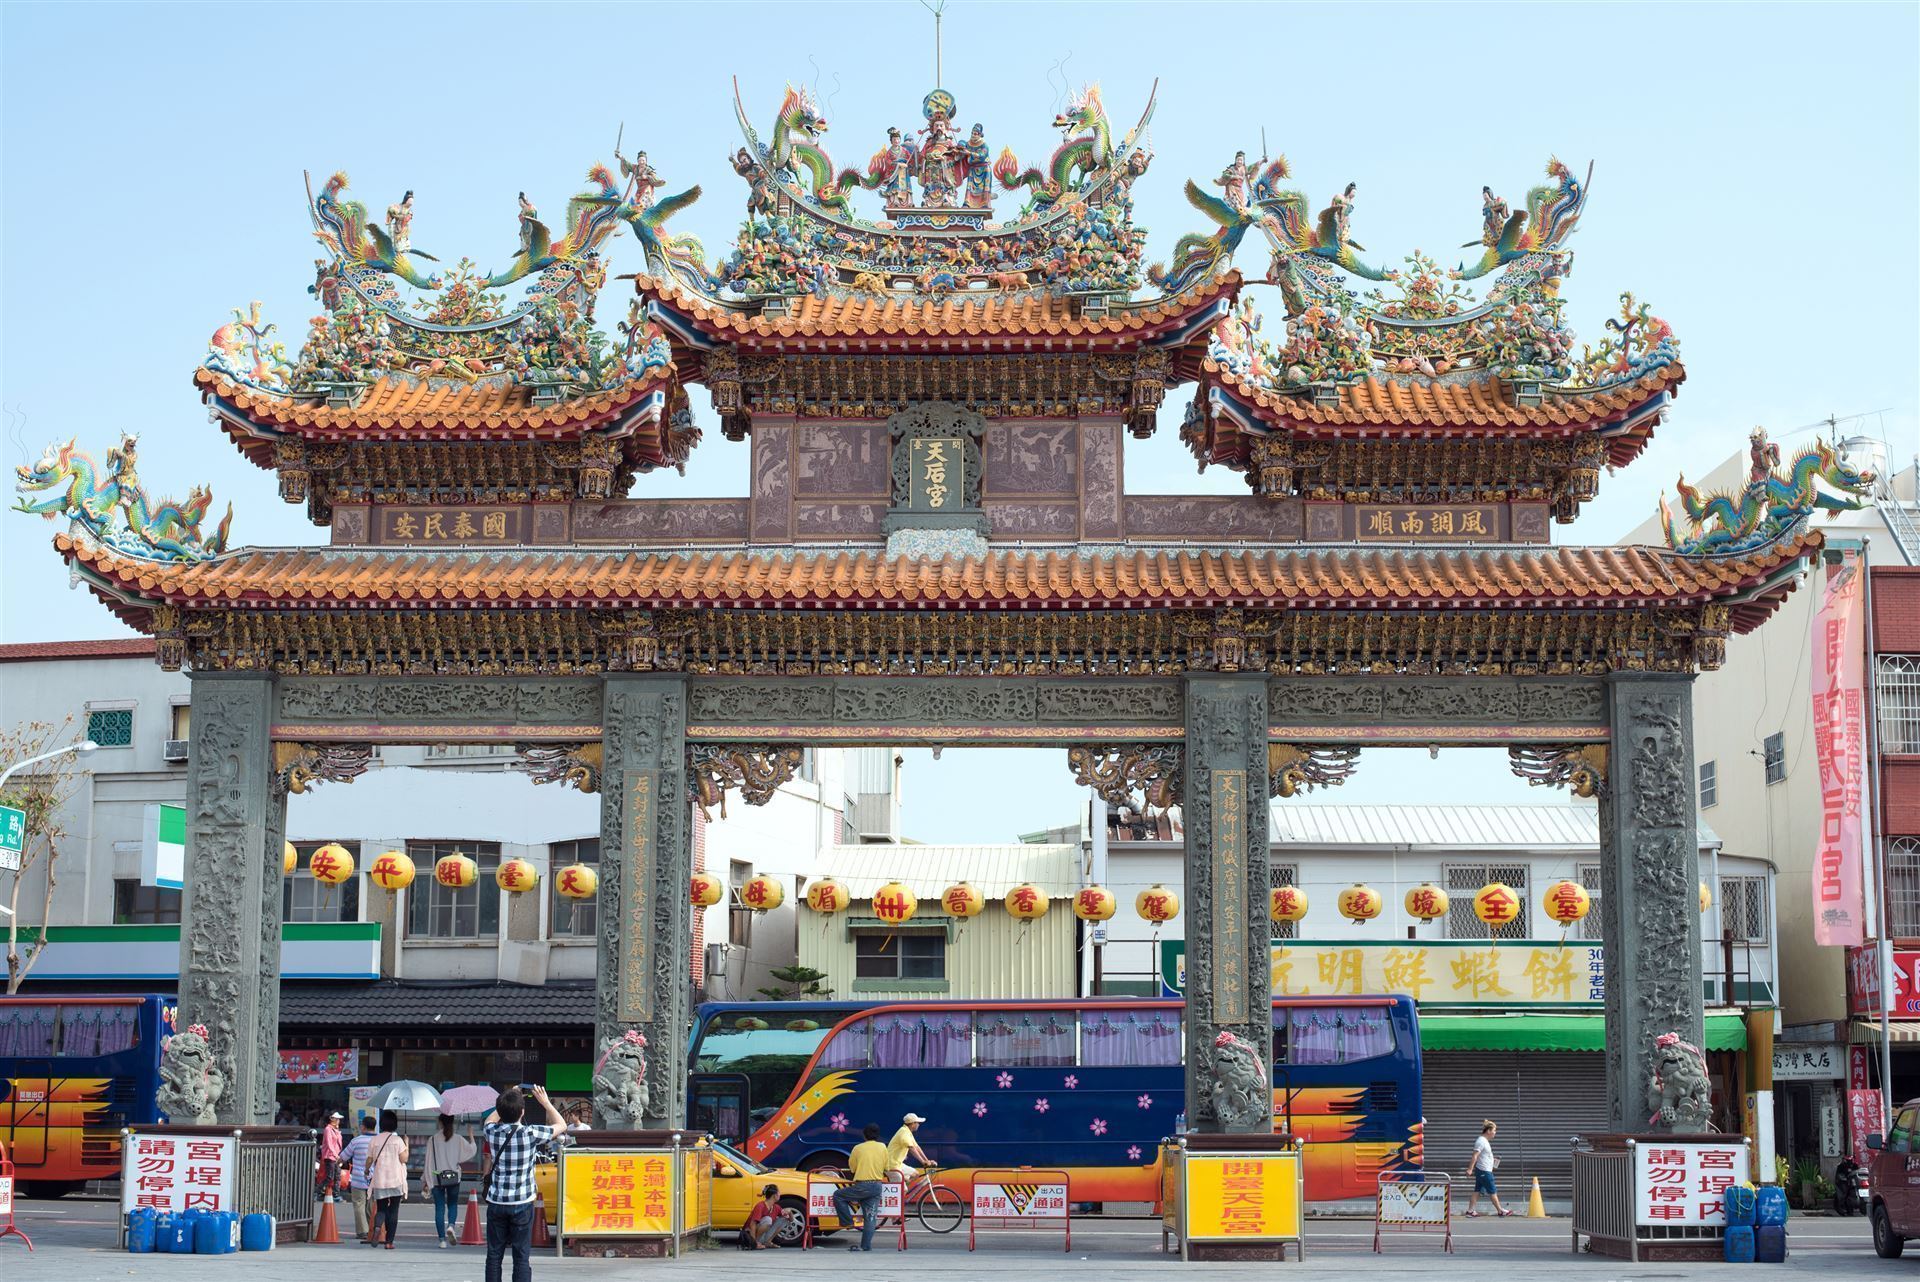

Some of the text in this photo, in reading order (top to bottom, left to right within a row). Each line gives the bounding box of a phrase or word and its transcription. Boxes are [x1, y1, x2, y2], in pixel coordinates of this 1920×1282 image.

[923, 441, 949, 508] 天后宮
[7, 834, 17, 845] Rd.
[311, 850, 585, 895] 安 平 開 臺 天
[745, 880, 768, 905] 母
[812, 885, 836, 912] 湄
[873, 891, 910, 920] 洲
[1011, 887, 1038, 913] 香
[1078, 889, 1105, 916] 聖
[1142, 895, 1169, 920] 駕
[1412, 890, 1442, 917] 境
[1480, 882, 1584, 921] 全 臺
[136, 1139, 176, 1209] 請勿停車
[184, 1141, 223, 1211] 宮埕內
[593, 1159, 635, 1172] 最早
[643, 1158, 666, 1218] 台灣本島
[1647, 1149, 1686, 1220] 請勿停車
[1697, 1150, 1736, 1221] 宮埕內
[591, 1174, 635, 1229] 媽祖廟
[976, 1196, 1064, 1209] 請留 通道
[1220, 1161, 1266, 1234] 開臺天后宮
